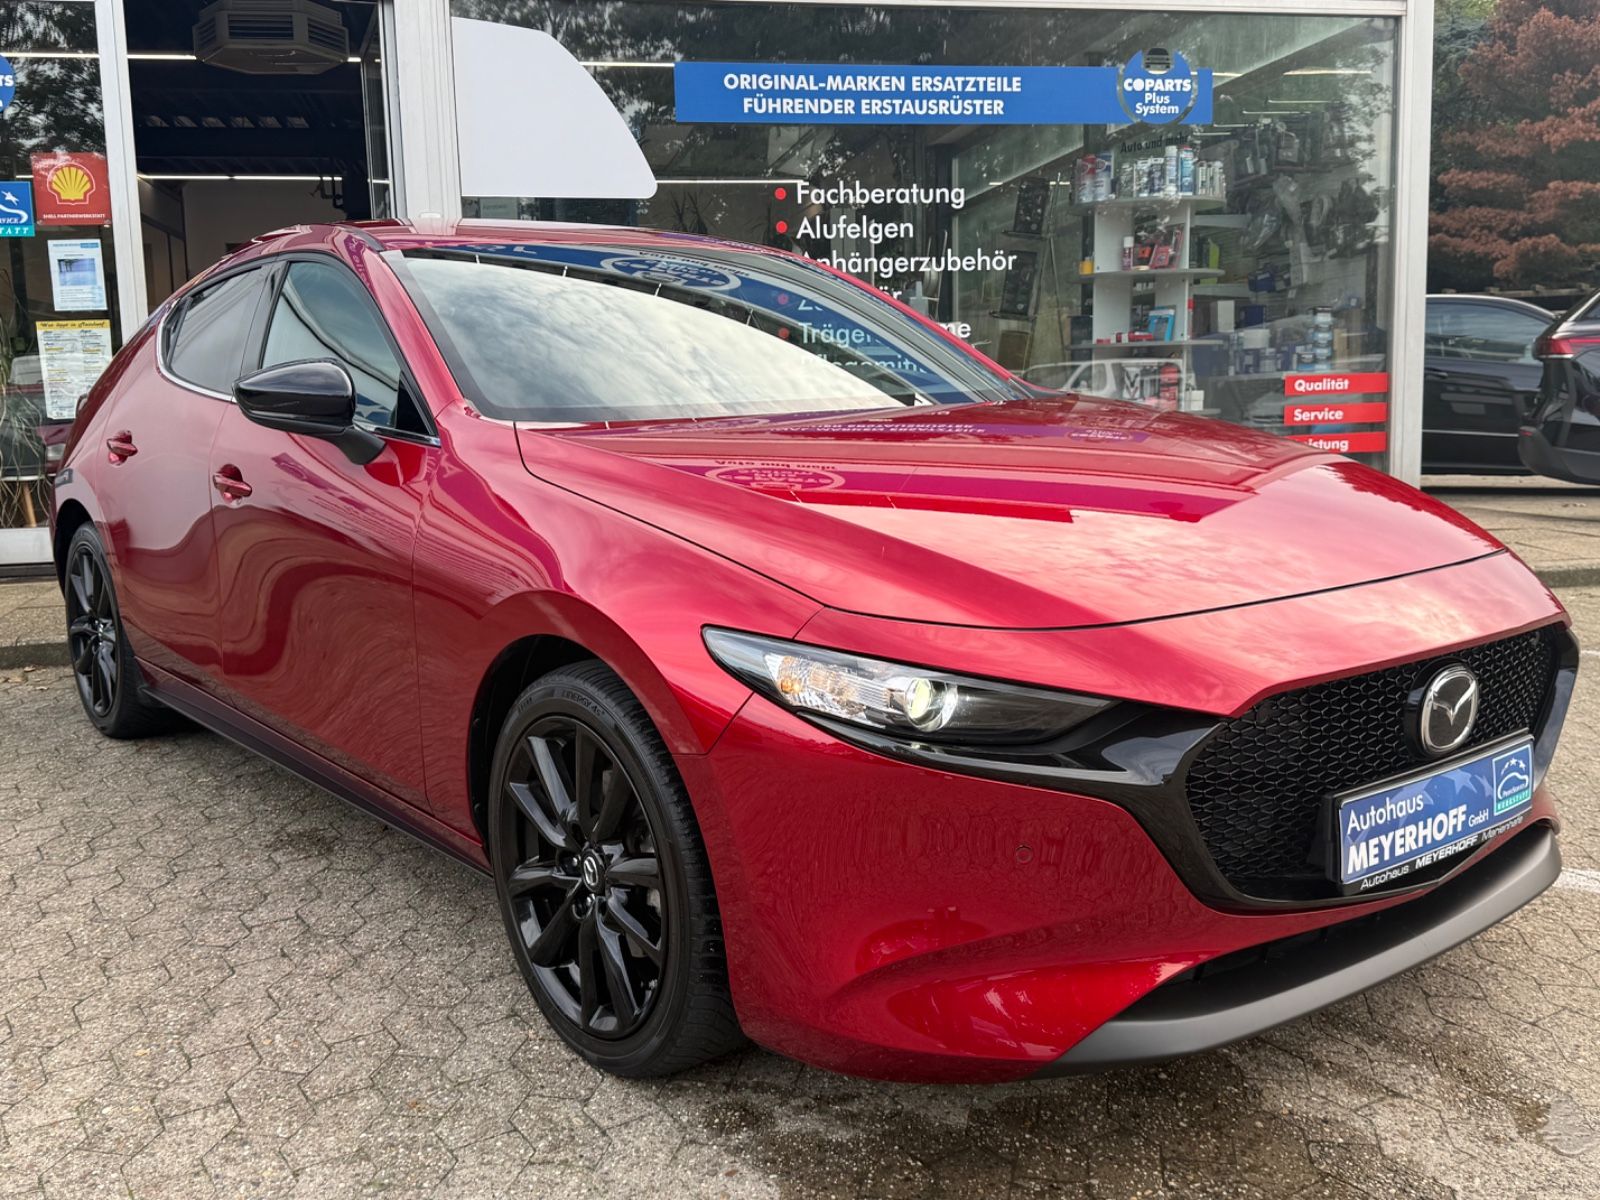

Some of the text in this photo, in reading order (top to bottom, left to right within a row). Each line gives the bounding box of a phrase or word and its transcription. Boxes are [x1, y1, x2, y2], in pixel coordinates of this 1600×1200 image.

[723, 73, 1022, 92] ORIGINAL-MARKEN ERSATZTEILE
[1123, 78, 1192, 92] COPARTS
[743, 93, 1004, 115] FÜHRENDER ERSTAUSRÜSTER
[1144, 92, 1170, 105] Plus
[1135, 102, 1180, 117] System
[1120, 141, 1143, 153] Auto
[1145, 135, 1163, 150] und
[796, 180, 966, 210] Fachberatung
[796, 215, 915, 244] Alufelgen
[1294, 378, 1350, 392] Qualität
[1293, 407, 1344, 421] Service
[1347, 793, 1424, 835] Autohaus
[1347, 804, 1490, 875] MEYERHOFF GmbH
[1360, 865, 1409, 890] Autohaus
[1415, 835, 1478, 870] MEYERHOFF
